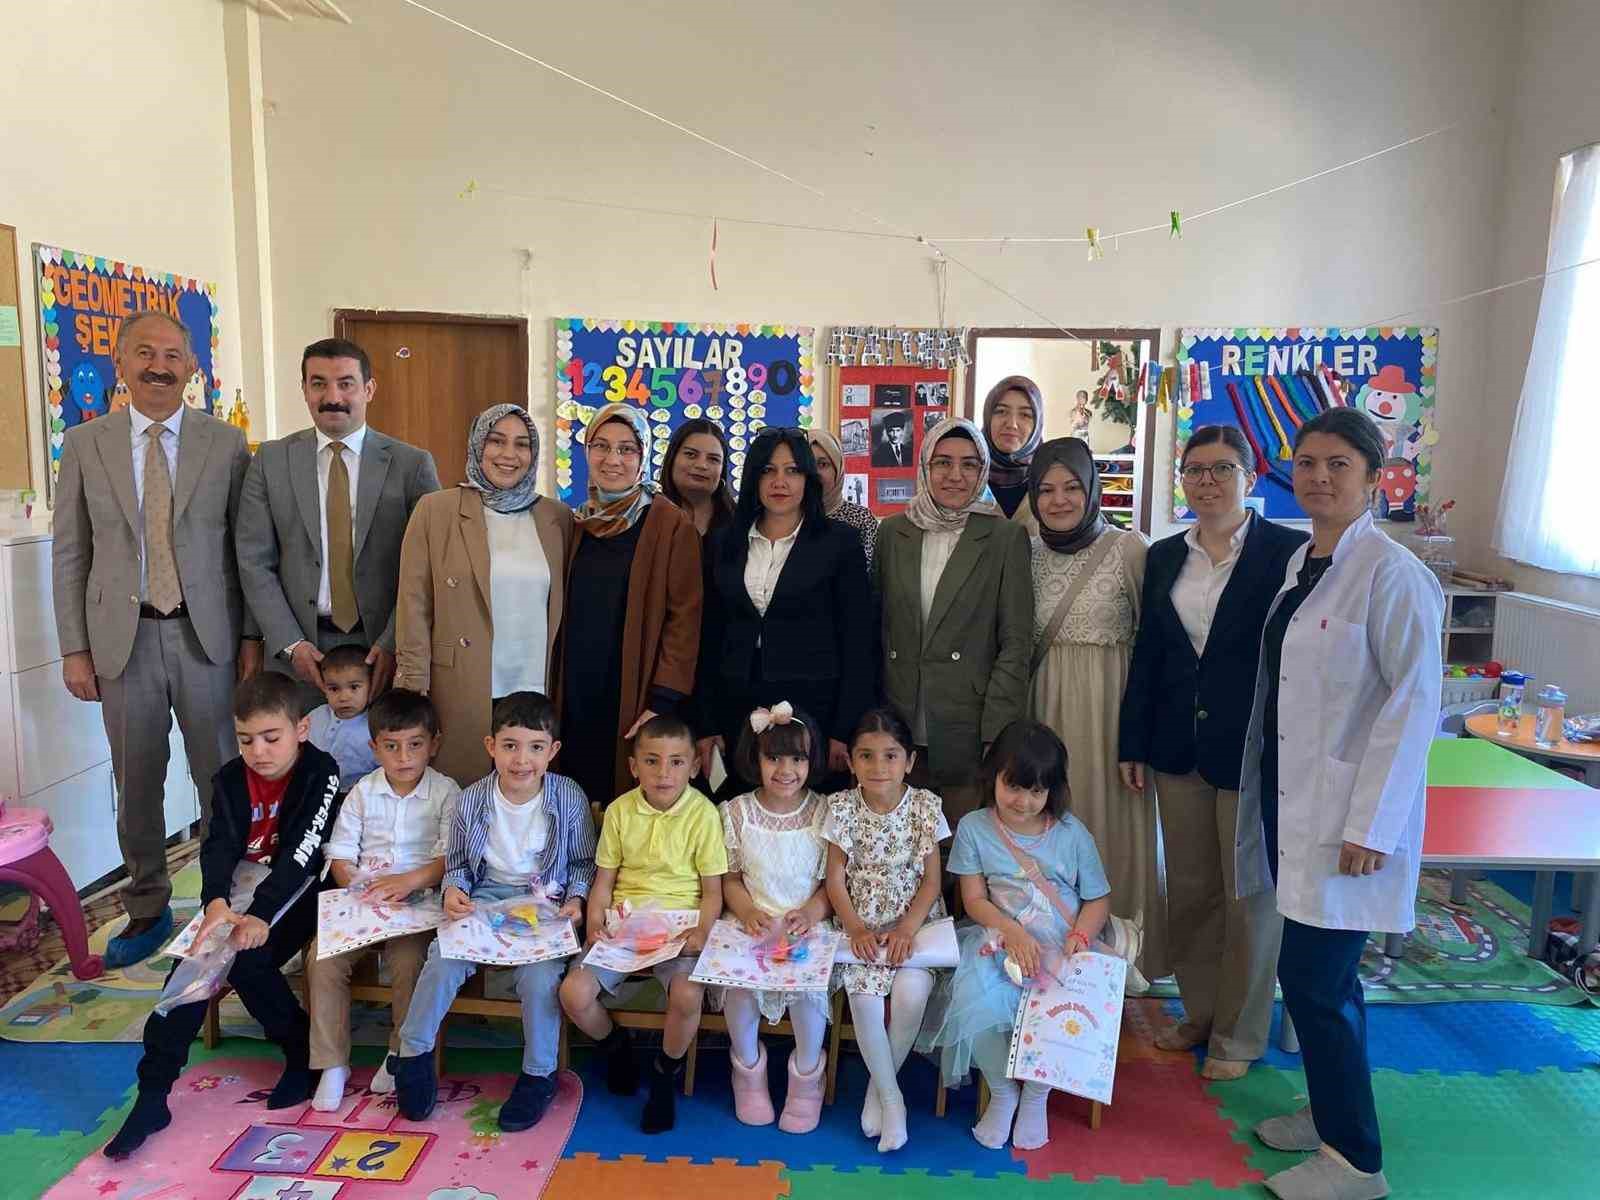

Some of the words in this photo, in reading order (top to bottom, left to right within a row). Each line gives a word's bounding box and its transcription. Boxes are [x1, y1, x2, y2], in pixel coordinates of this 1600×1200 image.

[616, 337, 743, 369] SAYILAR
[1222, 344, 1378, 376] RENKLER
[251, 1131, 305, 1165] 3
[356, 1140, 401, 1172] 2
